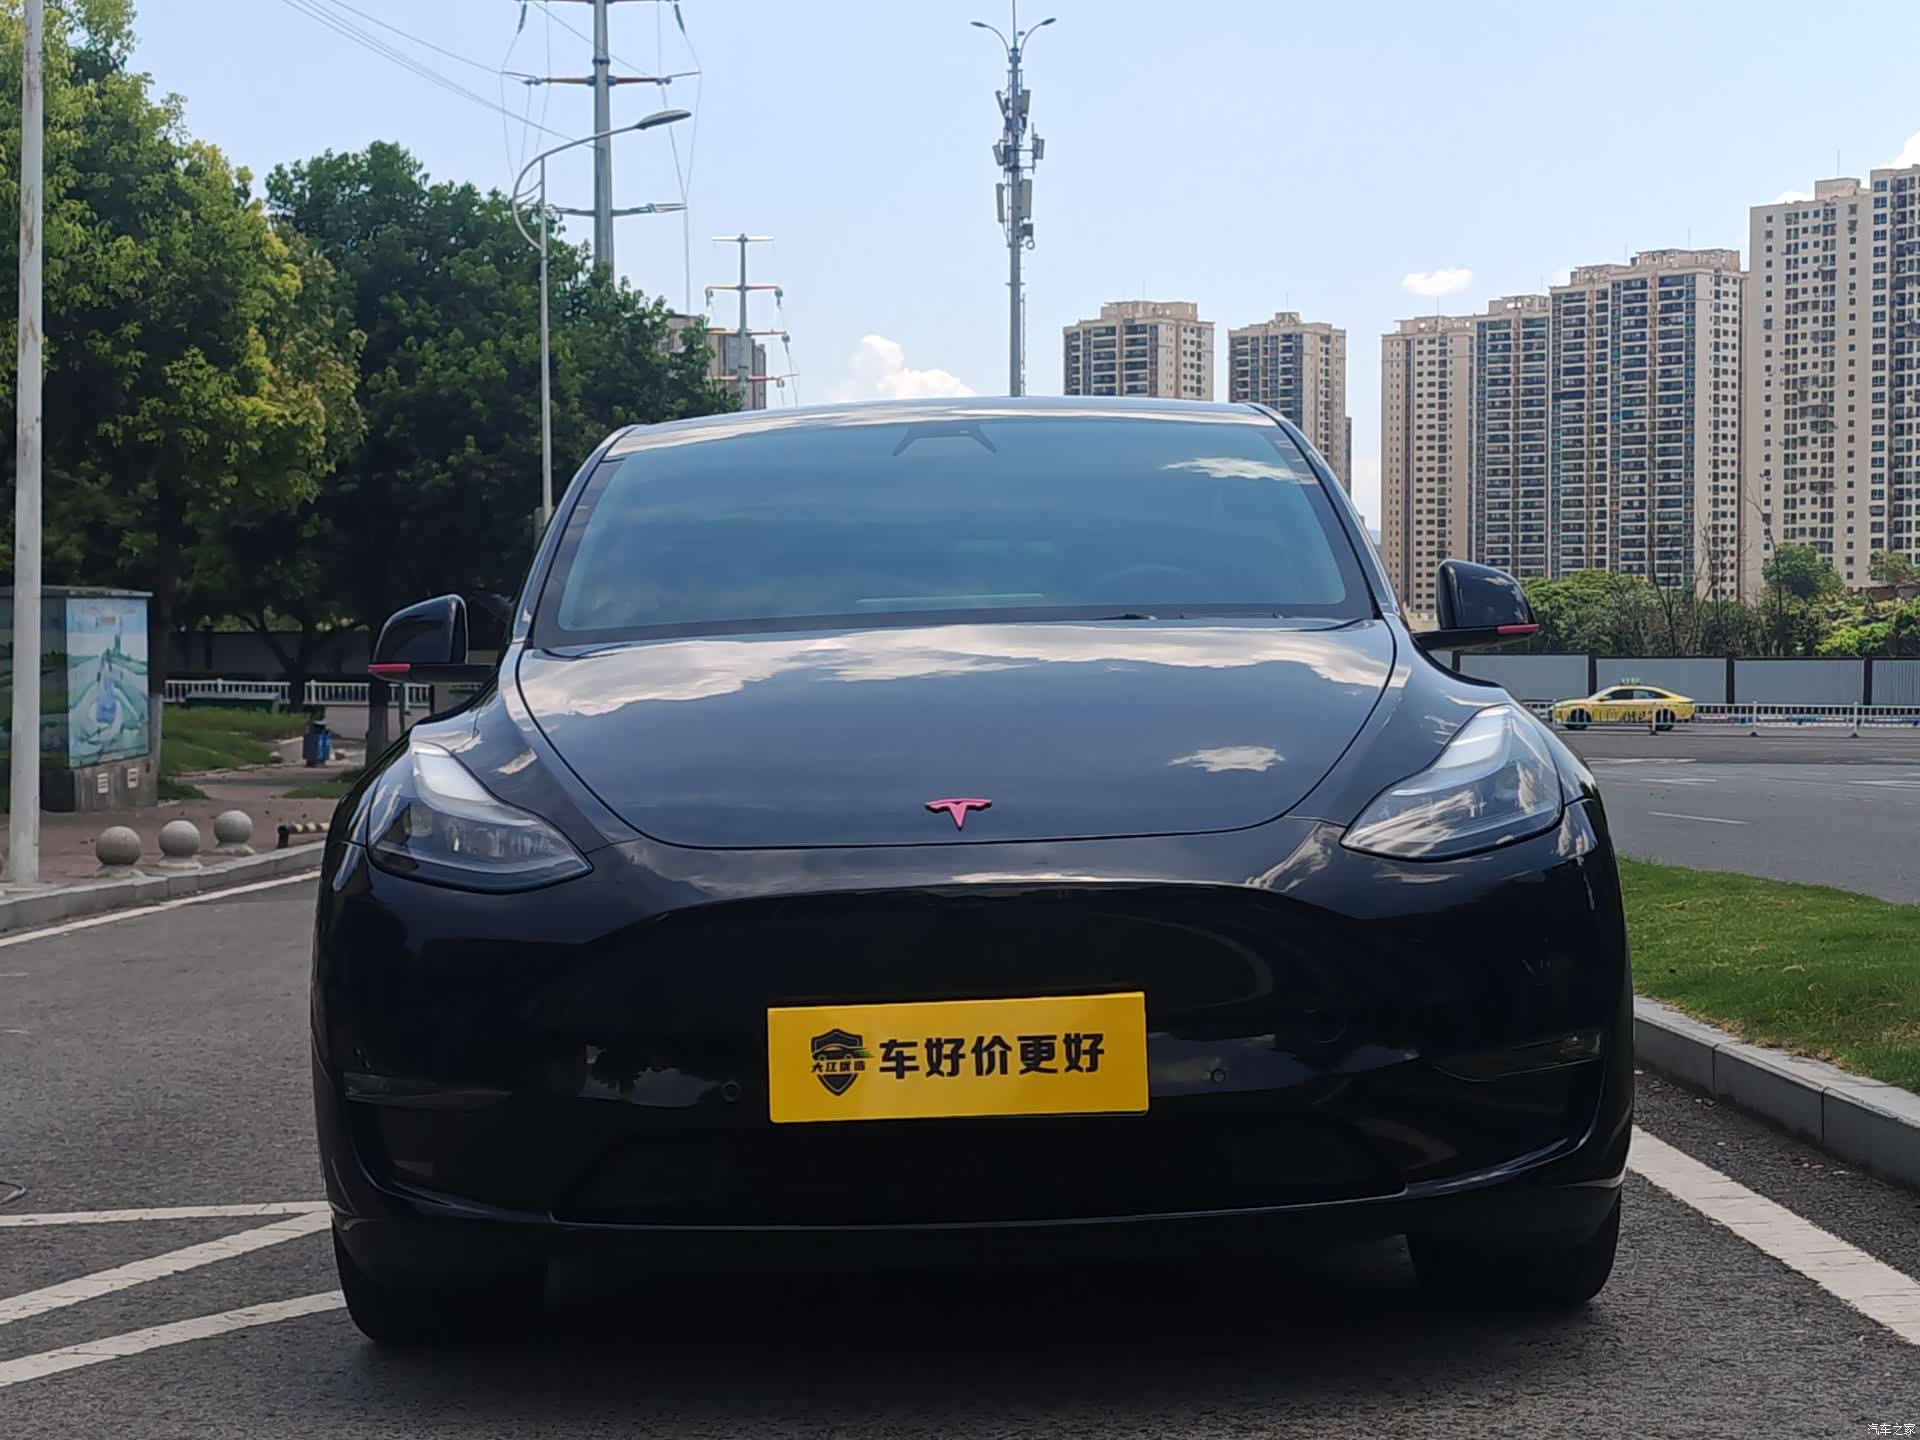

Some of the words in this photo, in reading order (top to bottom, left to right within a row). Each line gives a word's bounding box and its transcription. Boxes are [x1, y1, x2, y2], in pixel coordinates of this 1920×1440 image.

[879, 1033, 1104, 1079] 车好价更好
